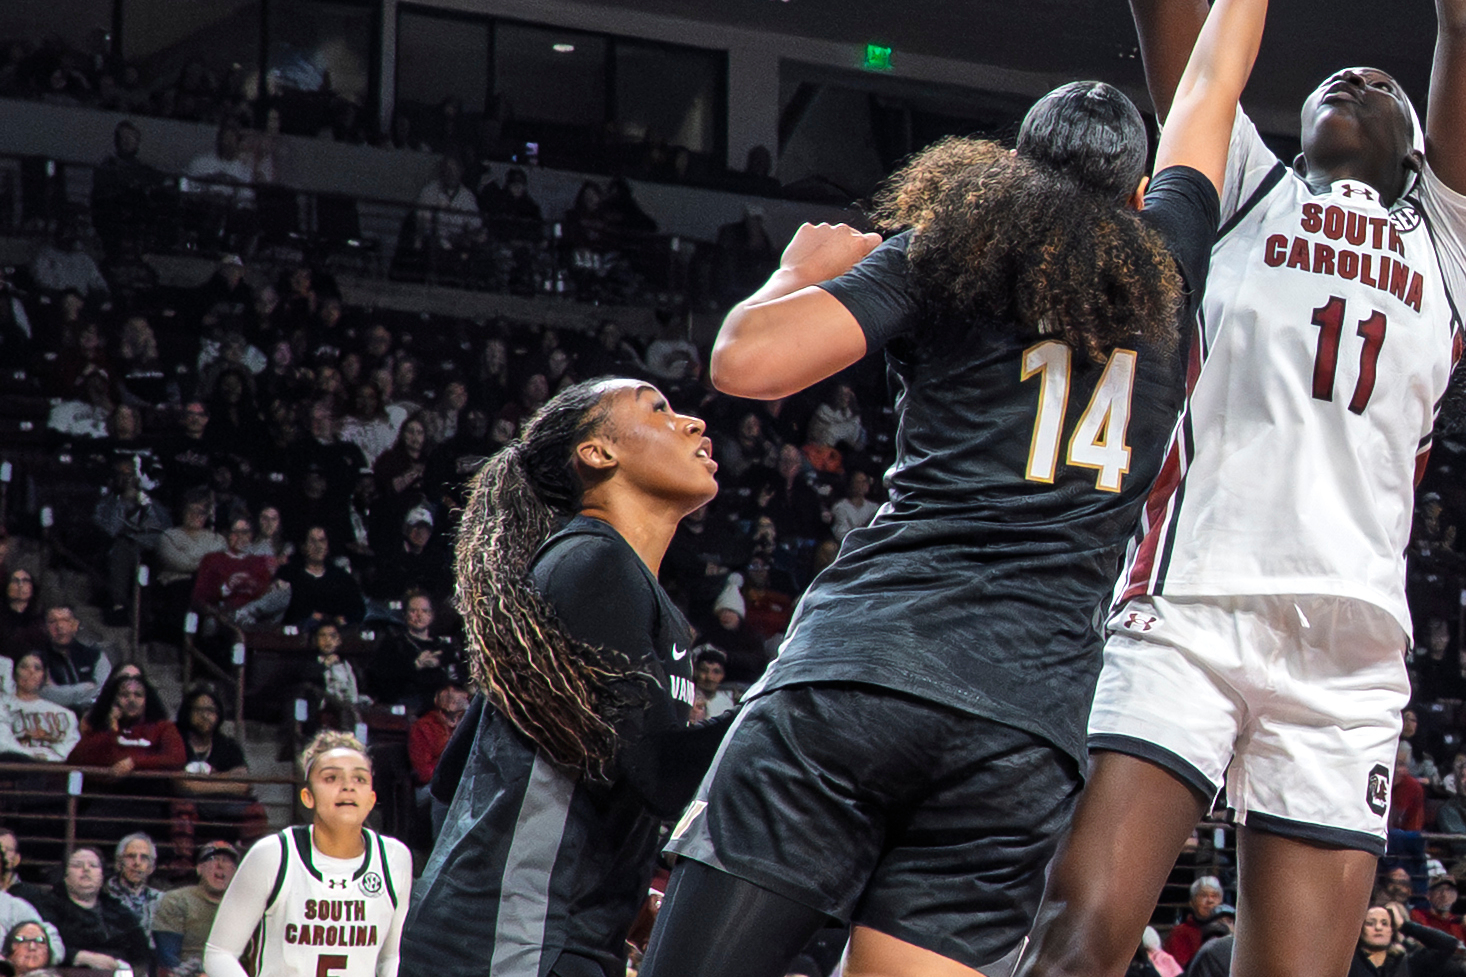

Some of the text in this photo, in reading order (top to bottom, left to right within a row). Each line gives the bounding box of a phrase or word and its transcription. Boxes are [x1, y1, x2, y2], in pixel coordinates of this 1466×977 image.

[1264, 234, 1424, 314] CAROLINA
[1310, 295, 1388, 415] 11
[1020, 339, 1138, 493] 14
[285, 924, 378, 946] CAROLINA
[304, 899, 366, 921] SOUTH
